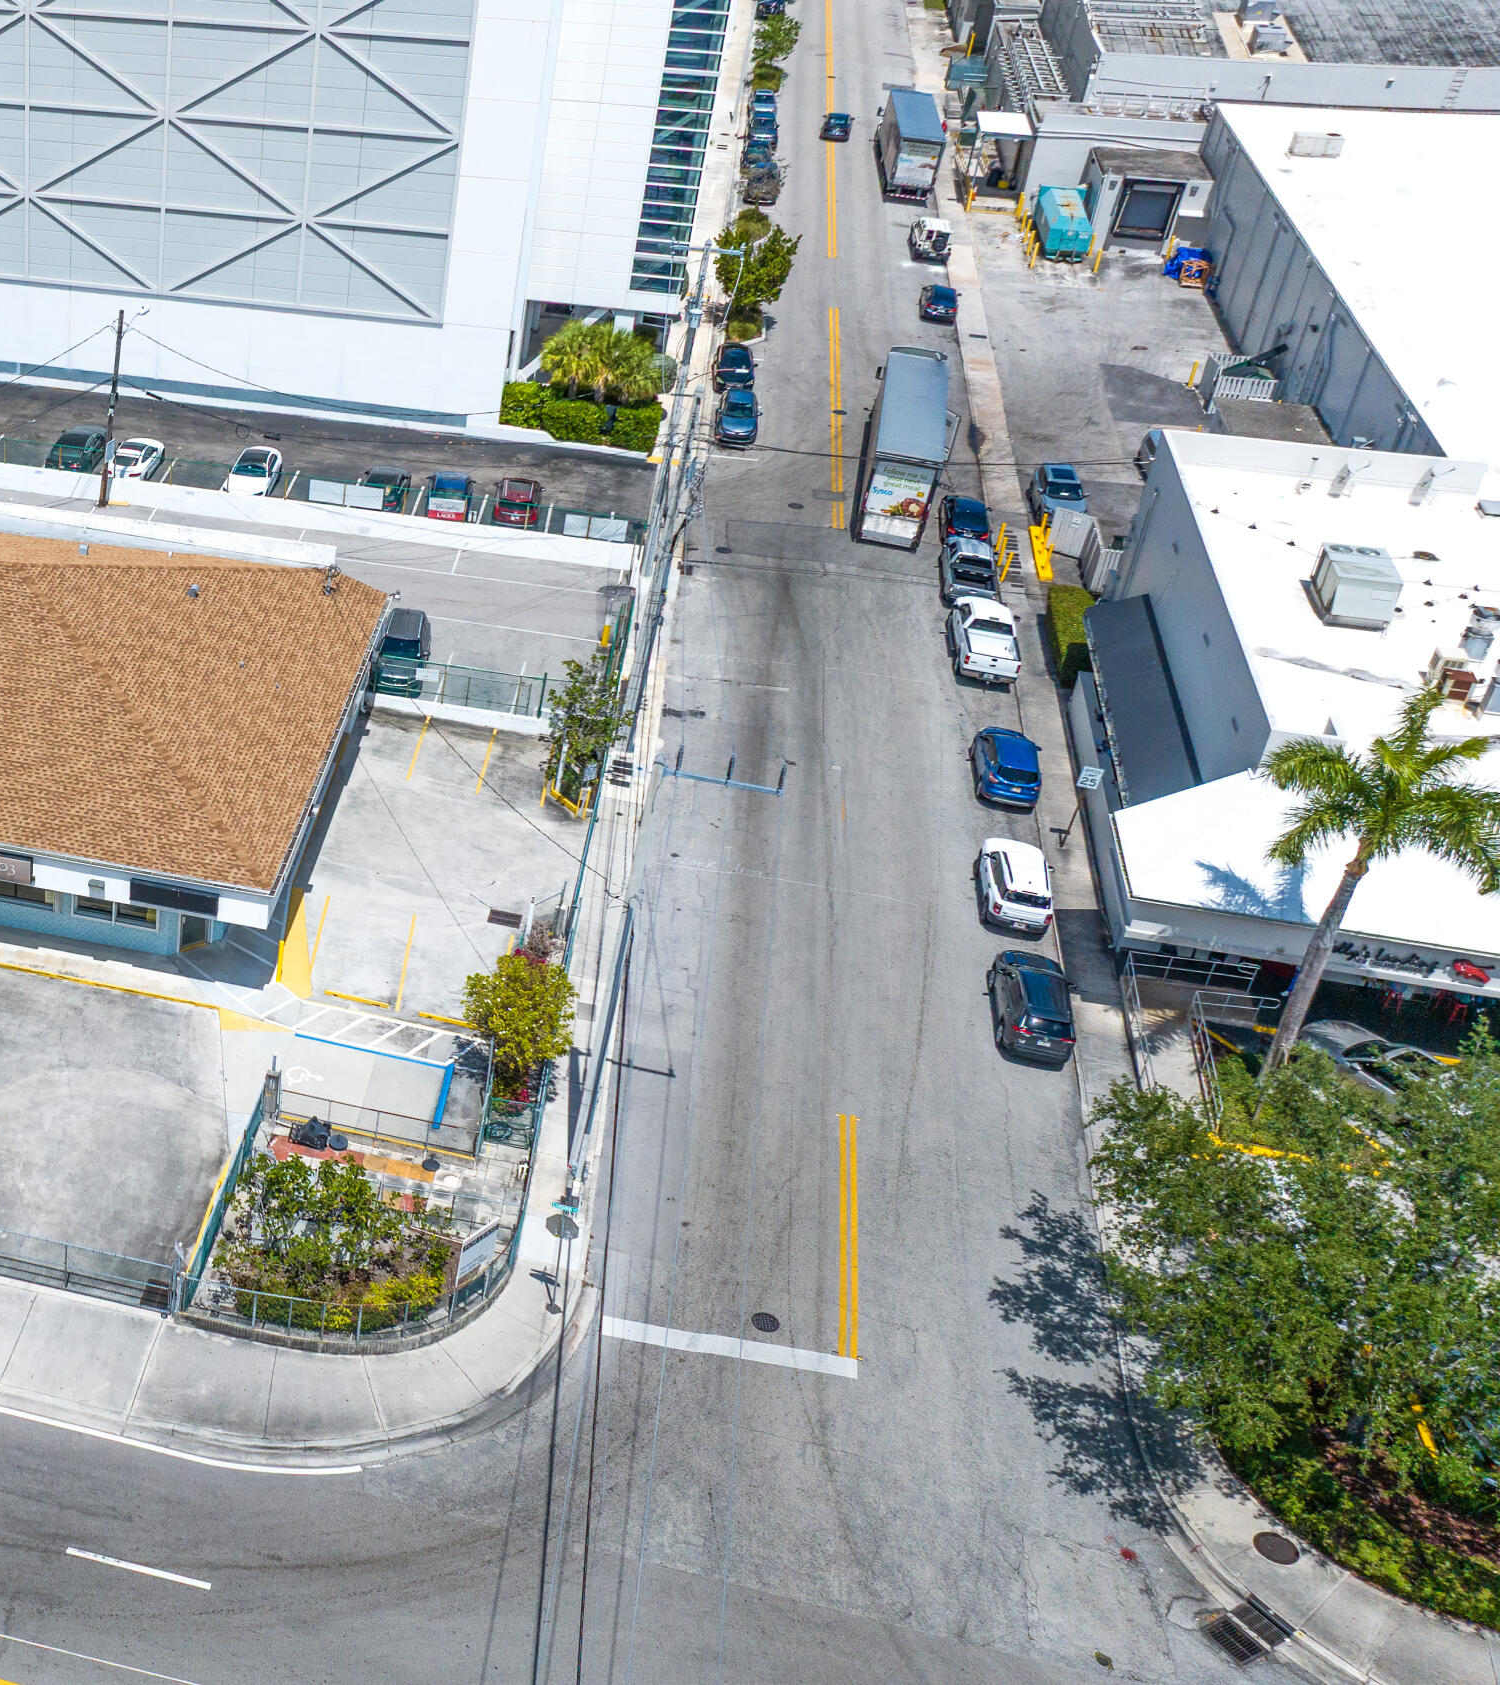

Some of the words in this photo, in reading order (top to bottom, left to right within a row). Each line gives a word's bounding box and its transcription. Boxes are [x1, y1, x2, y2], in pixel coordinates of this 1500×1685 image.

[883, 467, 906, 477] Follow
[883, 480, 902, 488] great
[871, 486, 894, 496] Sysco
[1079, 776, 1098, 787] 25
